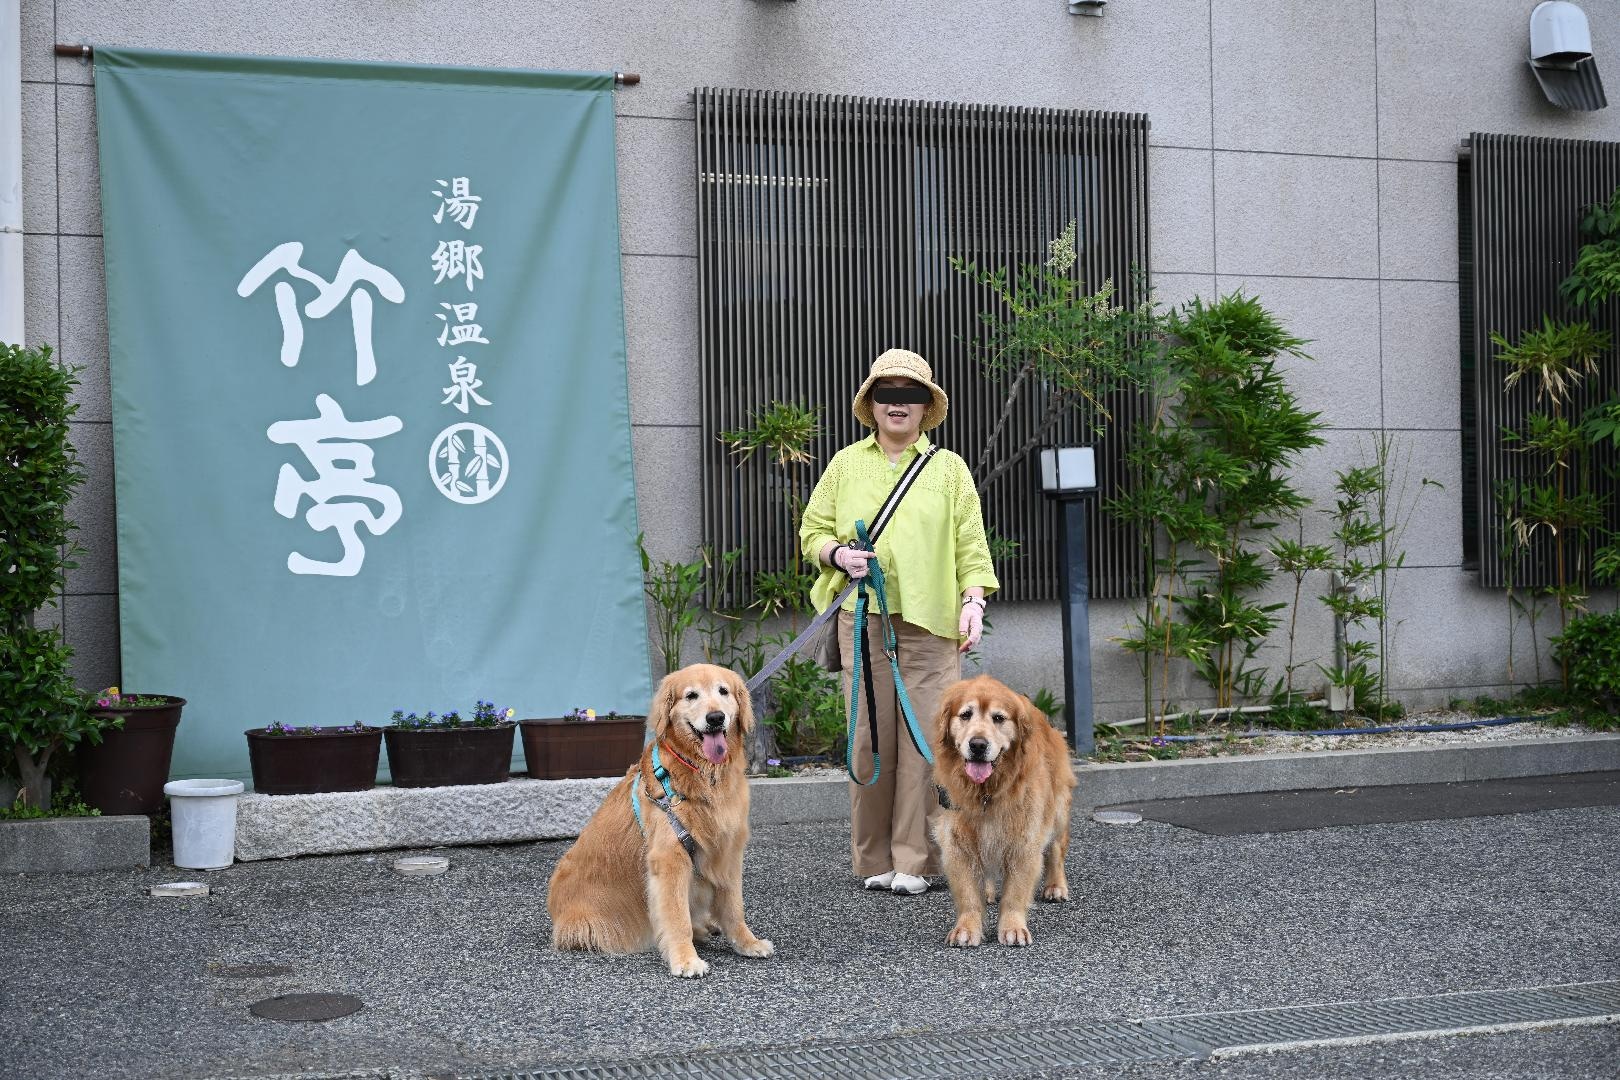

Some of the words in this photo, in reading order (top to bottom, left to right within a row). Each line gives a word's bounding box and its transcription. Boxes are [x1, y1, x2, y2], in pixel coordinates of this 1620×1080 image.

[237, 241, 405, 577] 竹亭
[431, 176, 493, 414] 湯郷温泉
